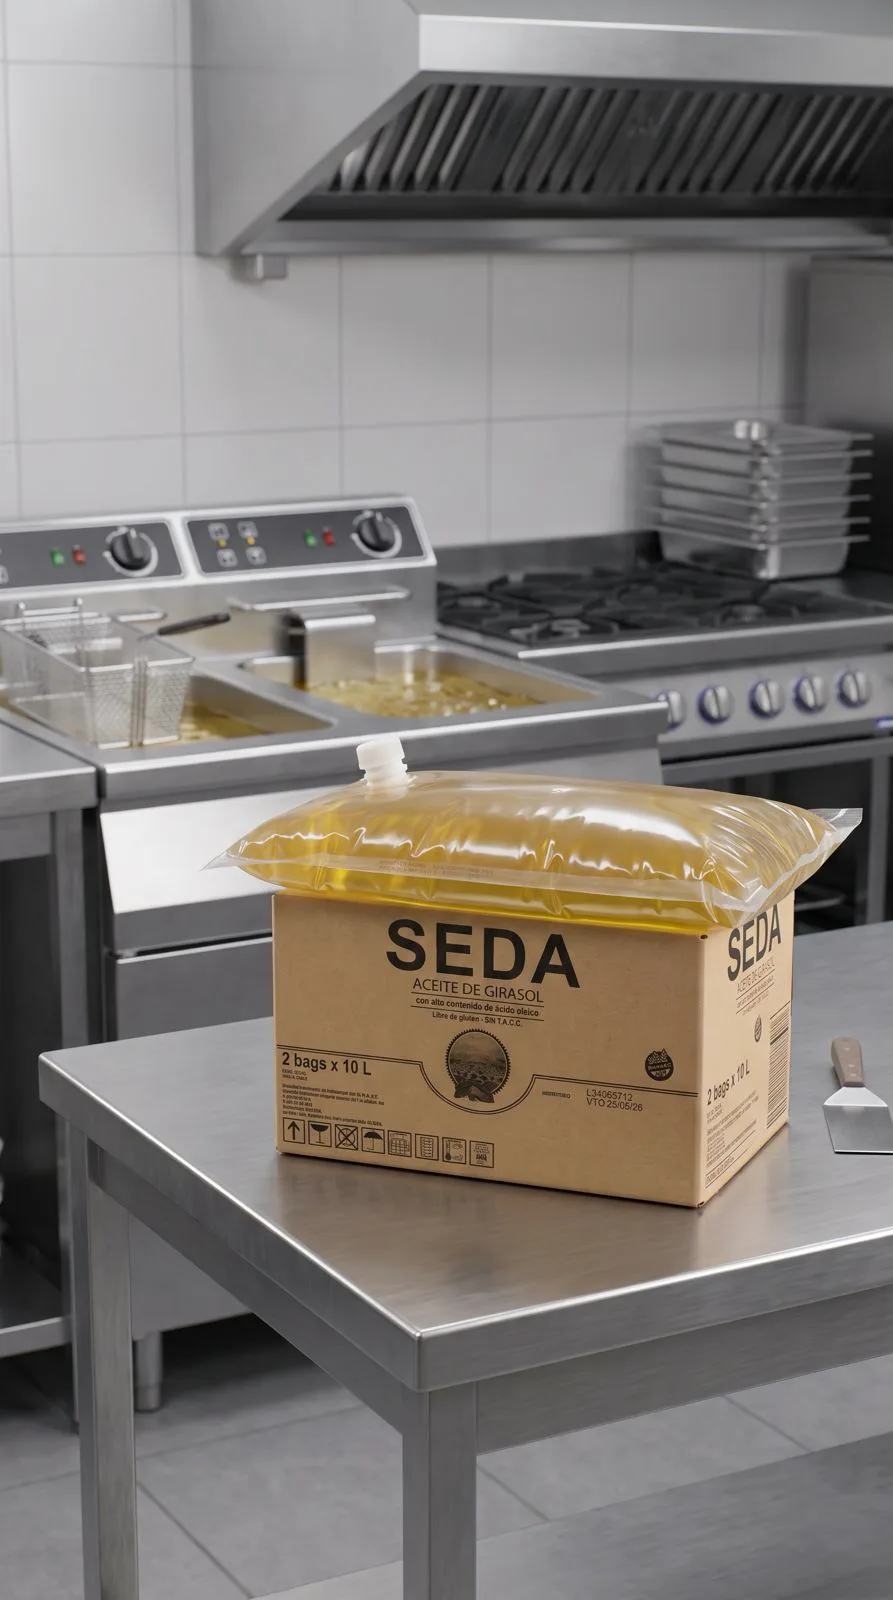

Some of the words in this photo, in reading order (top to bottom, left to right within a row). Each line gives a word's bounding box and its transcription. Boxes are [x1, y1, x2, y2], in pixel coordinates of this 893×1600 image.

[386, 918, 580, 988] SEDA
[727, 903, 781, 981] SEDA
[412, 978, 459, 994] ACEITE
[462, 983, 481, 996] DE
[484, 985, 545, 1003] GIRASOL
[415, 997, 430, 1005] con
[430, 998, 445, 1007] alto
[446, 1000, 483, 1011] contenido
[484, 1003, 493, 1012] de
[494, 1005, 515, 1014] ácido
[516, 1008, 539, 1017] oleico
[432, 1011, 449, 1020] Libre
[458, 1015, 480, 1023] gluten
[484, 1016, 496, 1025] SIN
[282, 1052, 290, 1066] 2
[294, 1053, 327, 1073] bags
[330, 1060, 339, 1072] x
[343, 1059, 359, 1074] 10
[363, 1061, 372, 1076] L
[707, 1088, 712, 1106] 2
[736, 1062, 745, 1083] 10
[745, 1058, 750, 1076] L
[586, 1089, 633, 1102] L34065712
[586, 1097, 606, 1108] VTO
[607, 1100, 643, 1112] 25/05/26
